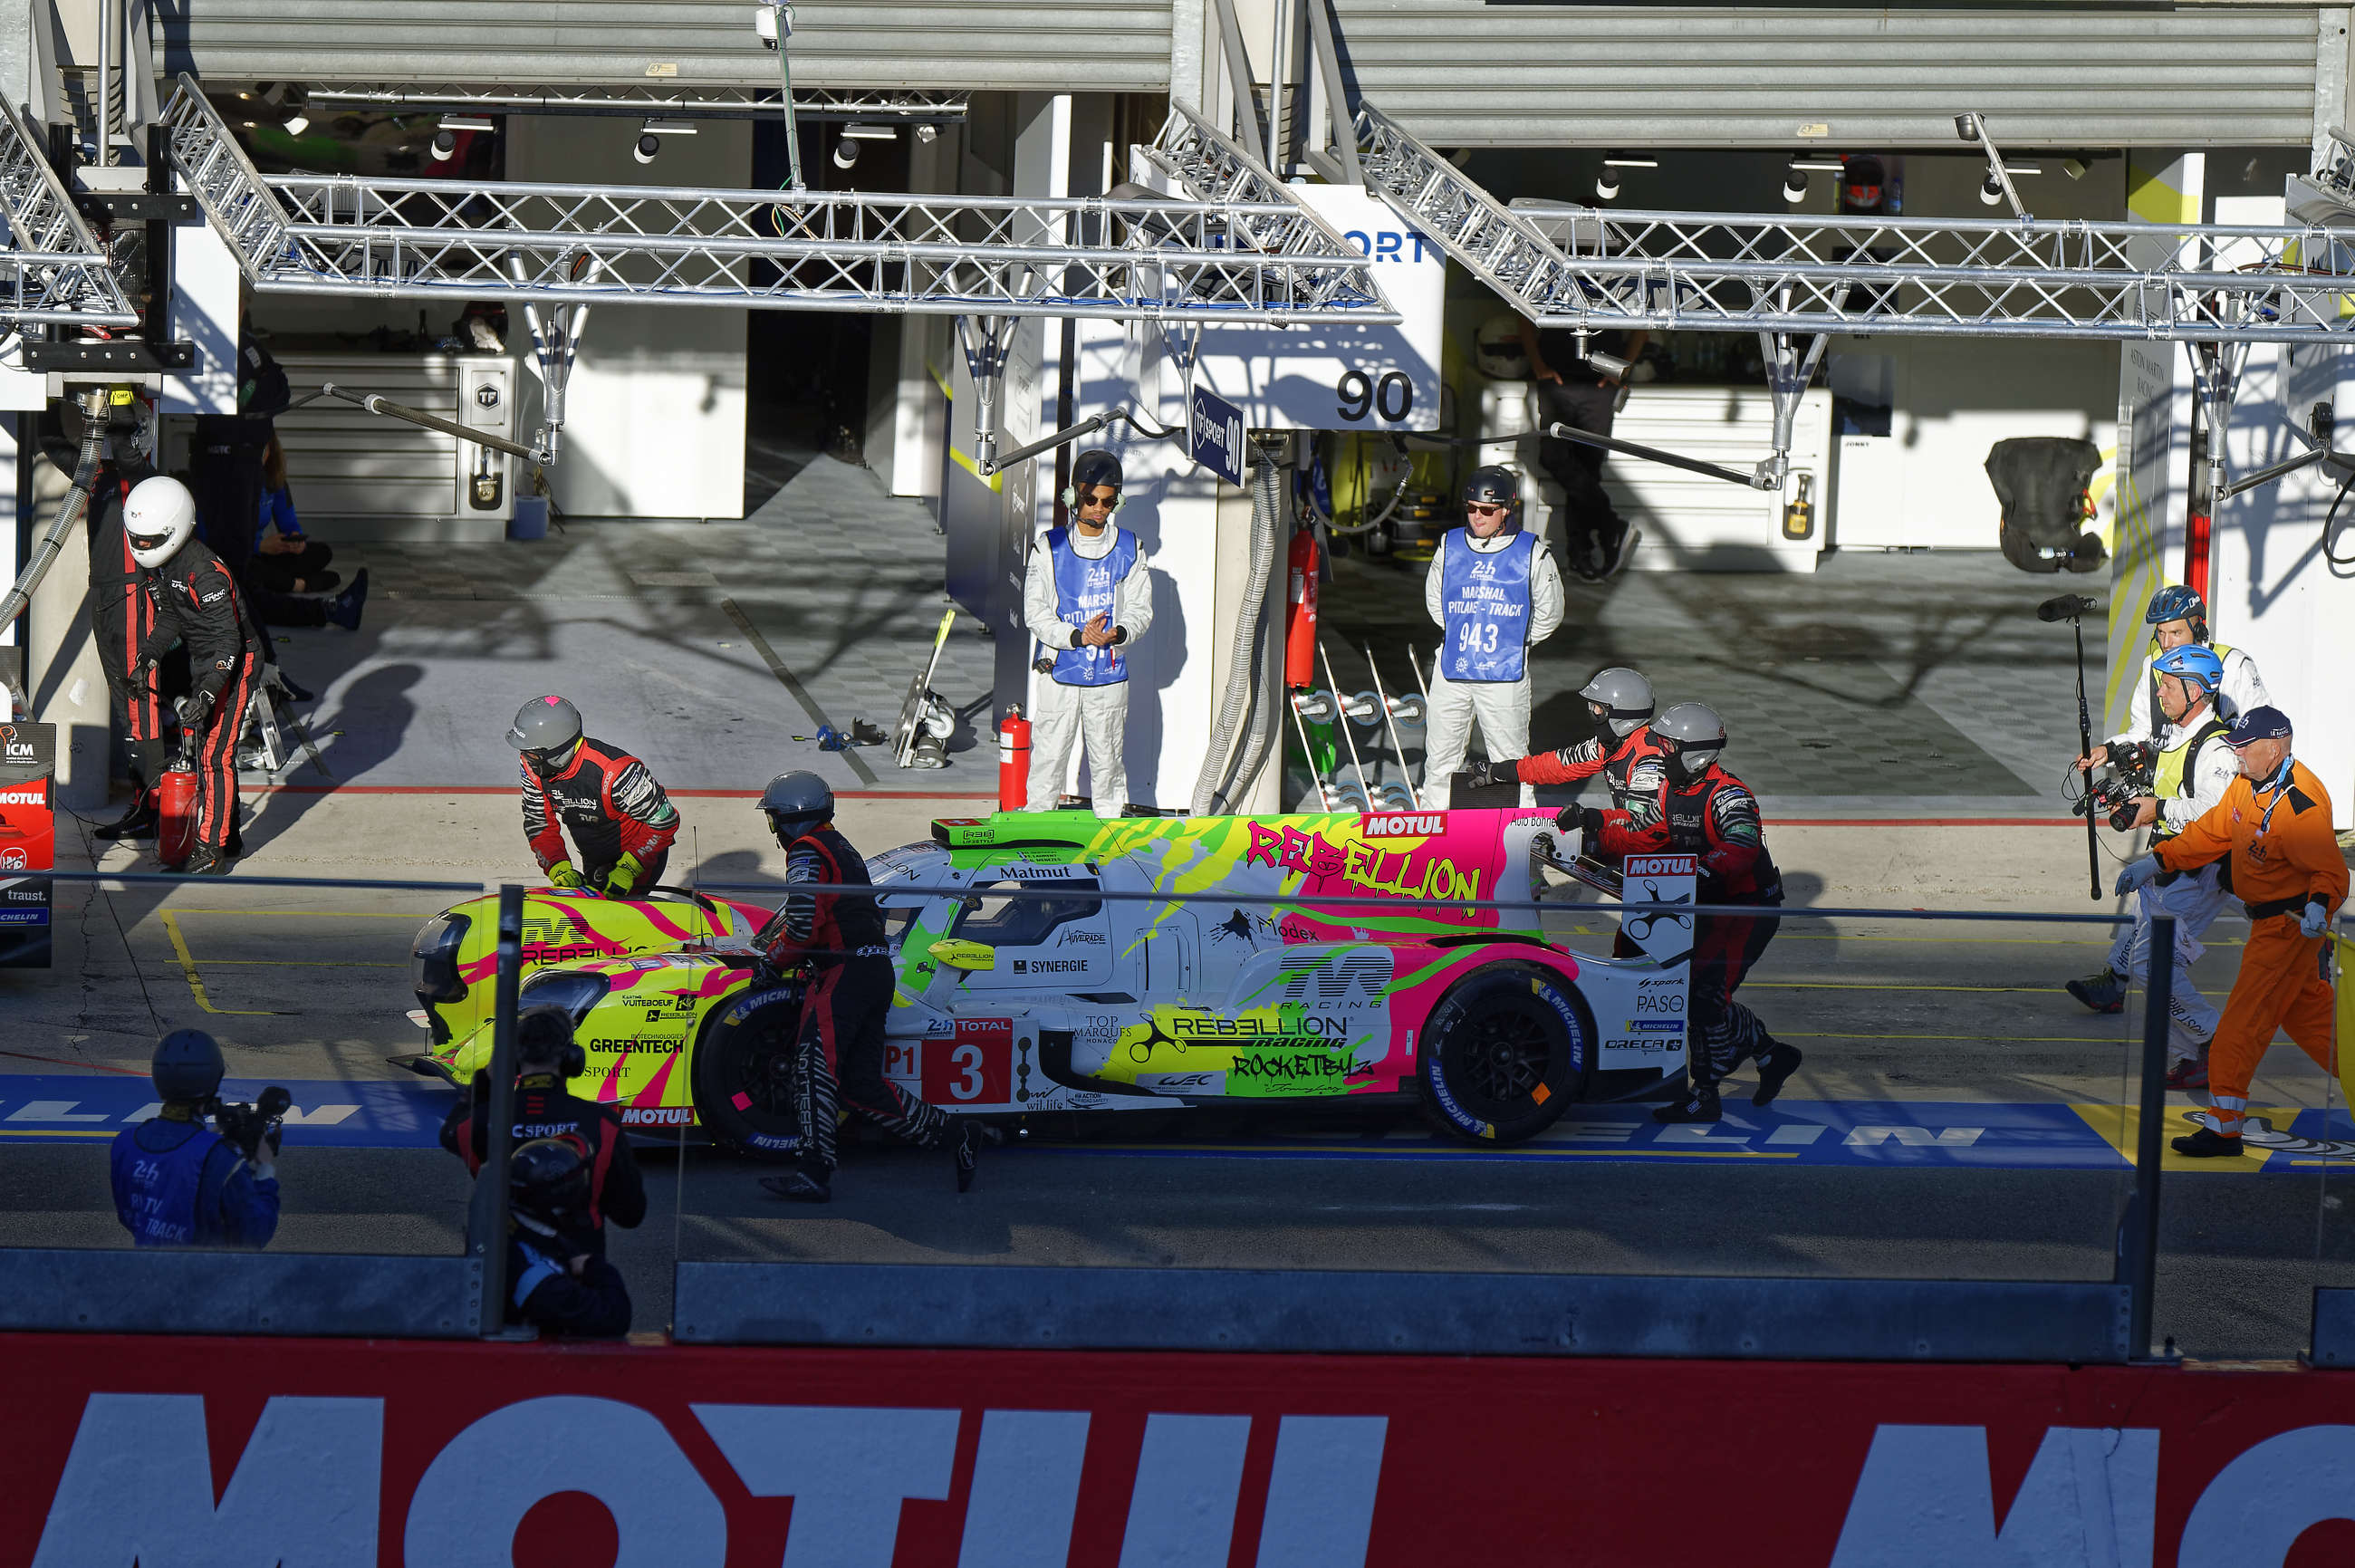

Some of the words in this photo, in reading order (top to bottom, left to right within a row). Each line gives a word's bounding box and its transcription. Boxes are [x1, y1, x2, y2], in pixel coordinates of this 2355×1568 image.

[1343, 230, 1431, 263] ORT
[479, 390, 497, 403] TF
[1337, 370, 1413, 422] 90
[1206, 418, 1225, 448] SPORT
[1226, 416, 1240, 475] 90
[1078, 592, 1115, 609] MARSH
[1462, 586, 1504, 601] MARSHAL
[1448, 601, 1479, 614] PITLANE
[1489, 602, 1524, 617] TRACK
[1459, 622, 1498, 653] 943
[226, 655, 236, 670] ICM
[6, 744, 34, 756] ICM
[0, 793, 45, 805] MOTUL
[1366, 815, 1445, 835] MOTUL
[1511, 813, 1529, 827] Auto
[1531, 812, 1558, 828] Bohne
[871, 852, 921, 881] ELLION
[1000, 866, 1071, 880] Matmut
[1246, 821, 1481, 919] REBELLION
[1630, 859, 1694, 874] MOTUL
[8, 890, 47, 902] traust.
[522, 918, 590, 946] TVR
[1255, 915, 1320, 942] Modex
[1031, 960, 1089, 973] SYNERGIE
[1279, 957, 1394, 997] TVR
[1651, 977, 1685, 987] spark
[622, 999, 674, 1007] VUITEBOEUF
[1280, 1001, 1382, 1009] RACING
[957, 1020, 1010, 1032] TOTAL
[1086, 1015, 1119, 1028] TOP
[1074, 1027, 1132, 1038] MARQUES
[1551, 996, 1583, 1064] MICHELIN
[590, 1038, 684, 1053] GREENTECH
[1605, 1039, 1665, 1049] ORECA
[584, 1065, 631, 1078] SPORT
[949, 1044, 984, 1101] 3
[1158, 1074, 1214, 1086] WEC
[1431, 1064, 1474, 1128] MICHELIN
[621, 1108, 692, 1124] MOTUL
[524, 1121, 580, 1138] SPORT
[146, 1217, 188, 1241] TRACK
[32, 1392, 1390, 1568] MOTUL
